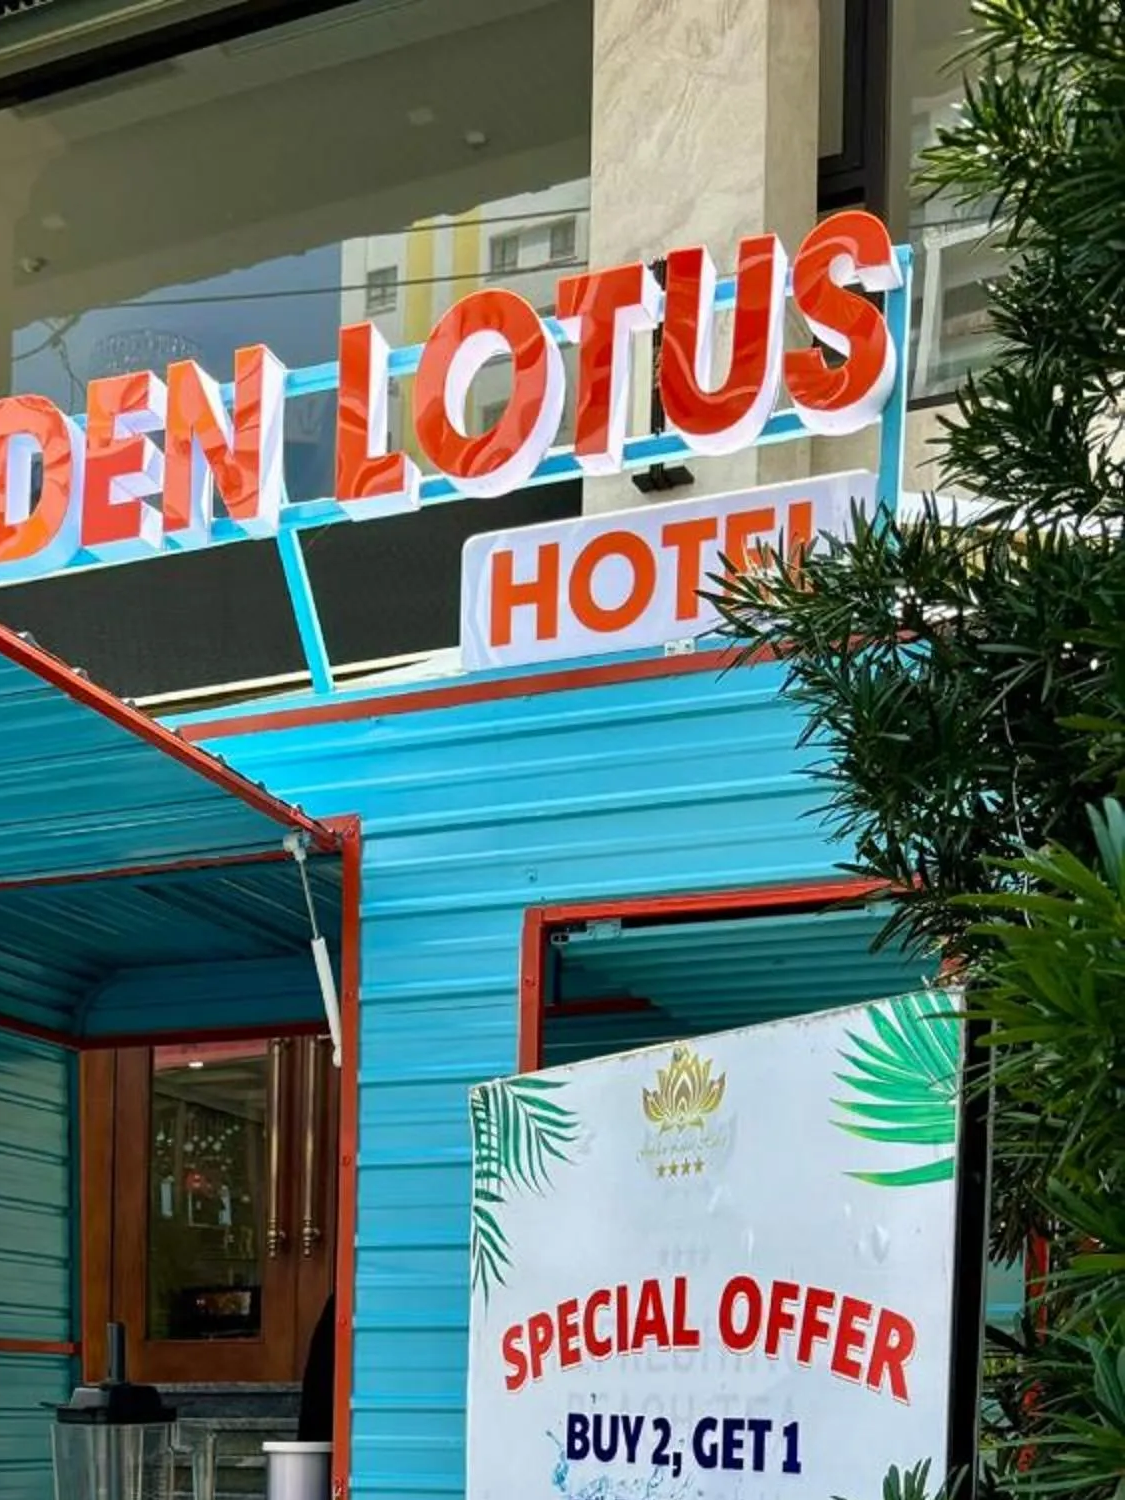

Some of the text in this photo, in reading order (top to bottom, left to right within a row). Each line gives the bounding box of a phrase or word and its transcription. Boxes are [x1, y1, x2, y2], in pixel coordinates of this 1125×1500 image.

[334, 210, 900, 520] LOTUS
[501, 1274, 918, 1407] SPECIAL OFFER
[566, 1413, 645, 1464] BUY
[692, 1416, 773, 1472] GET
[781, 1421, 802, 1474] 1
